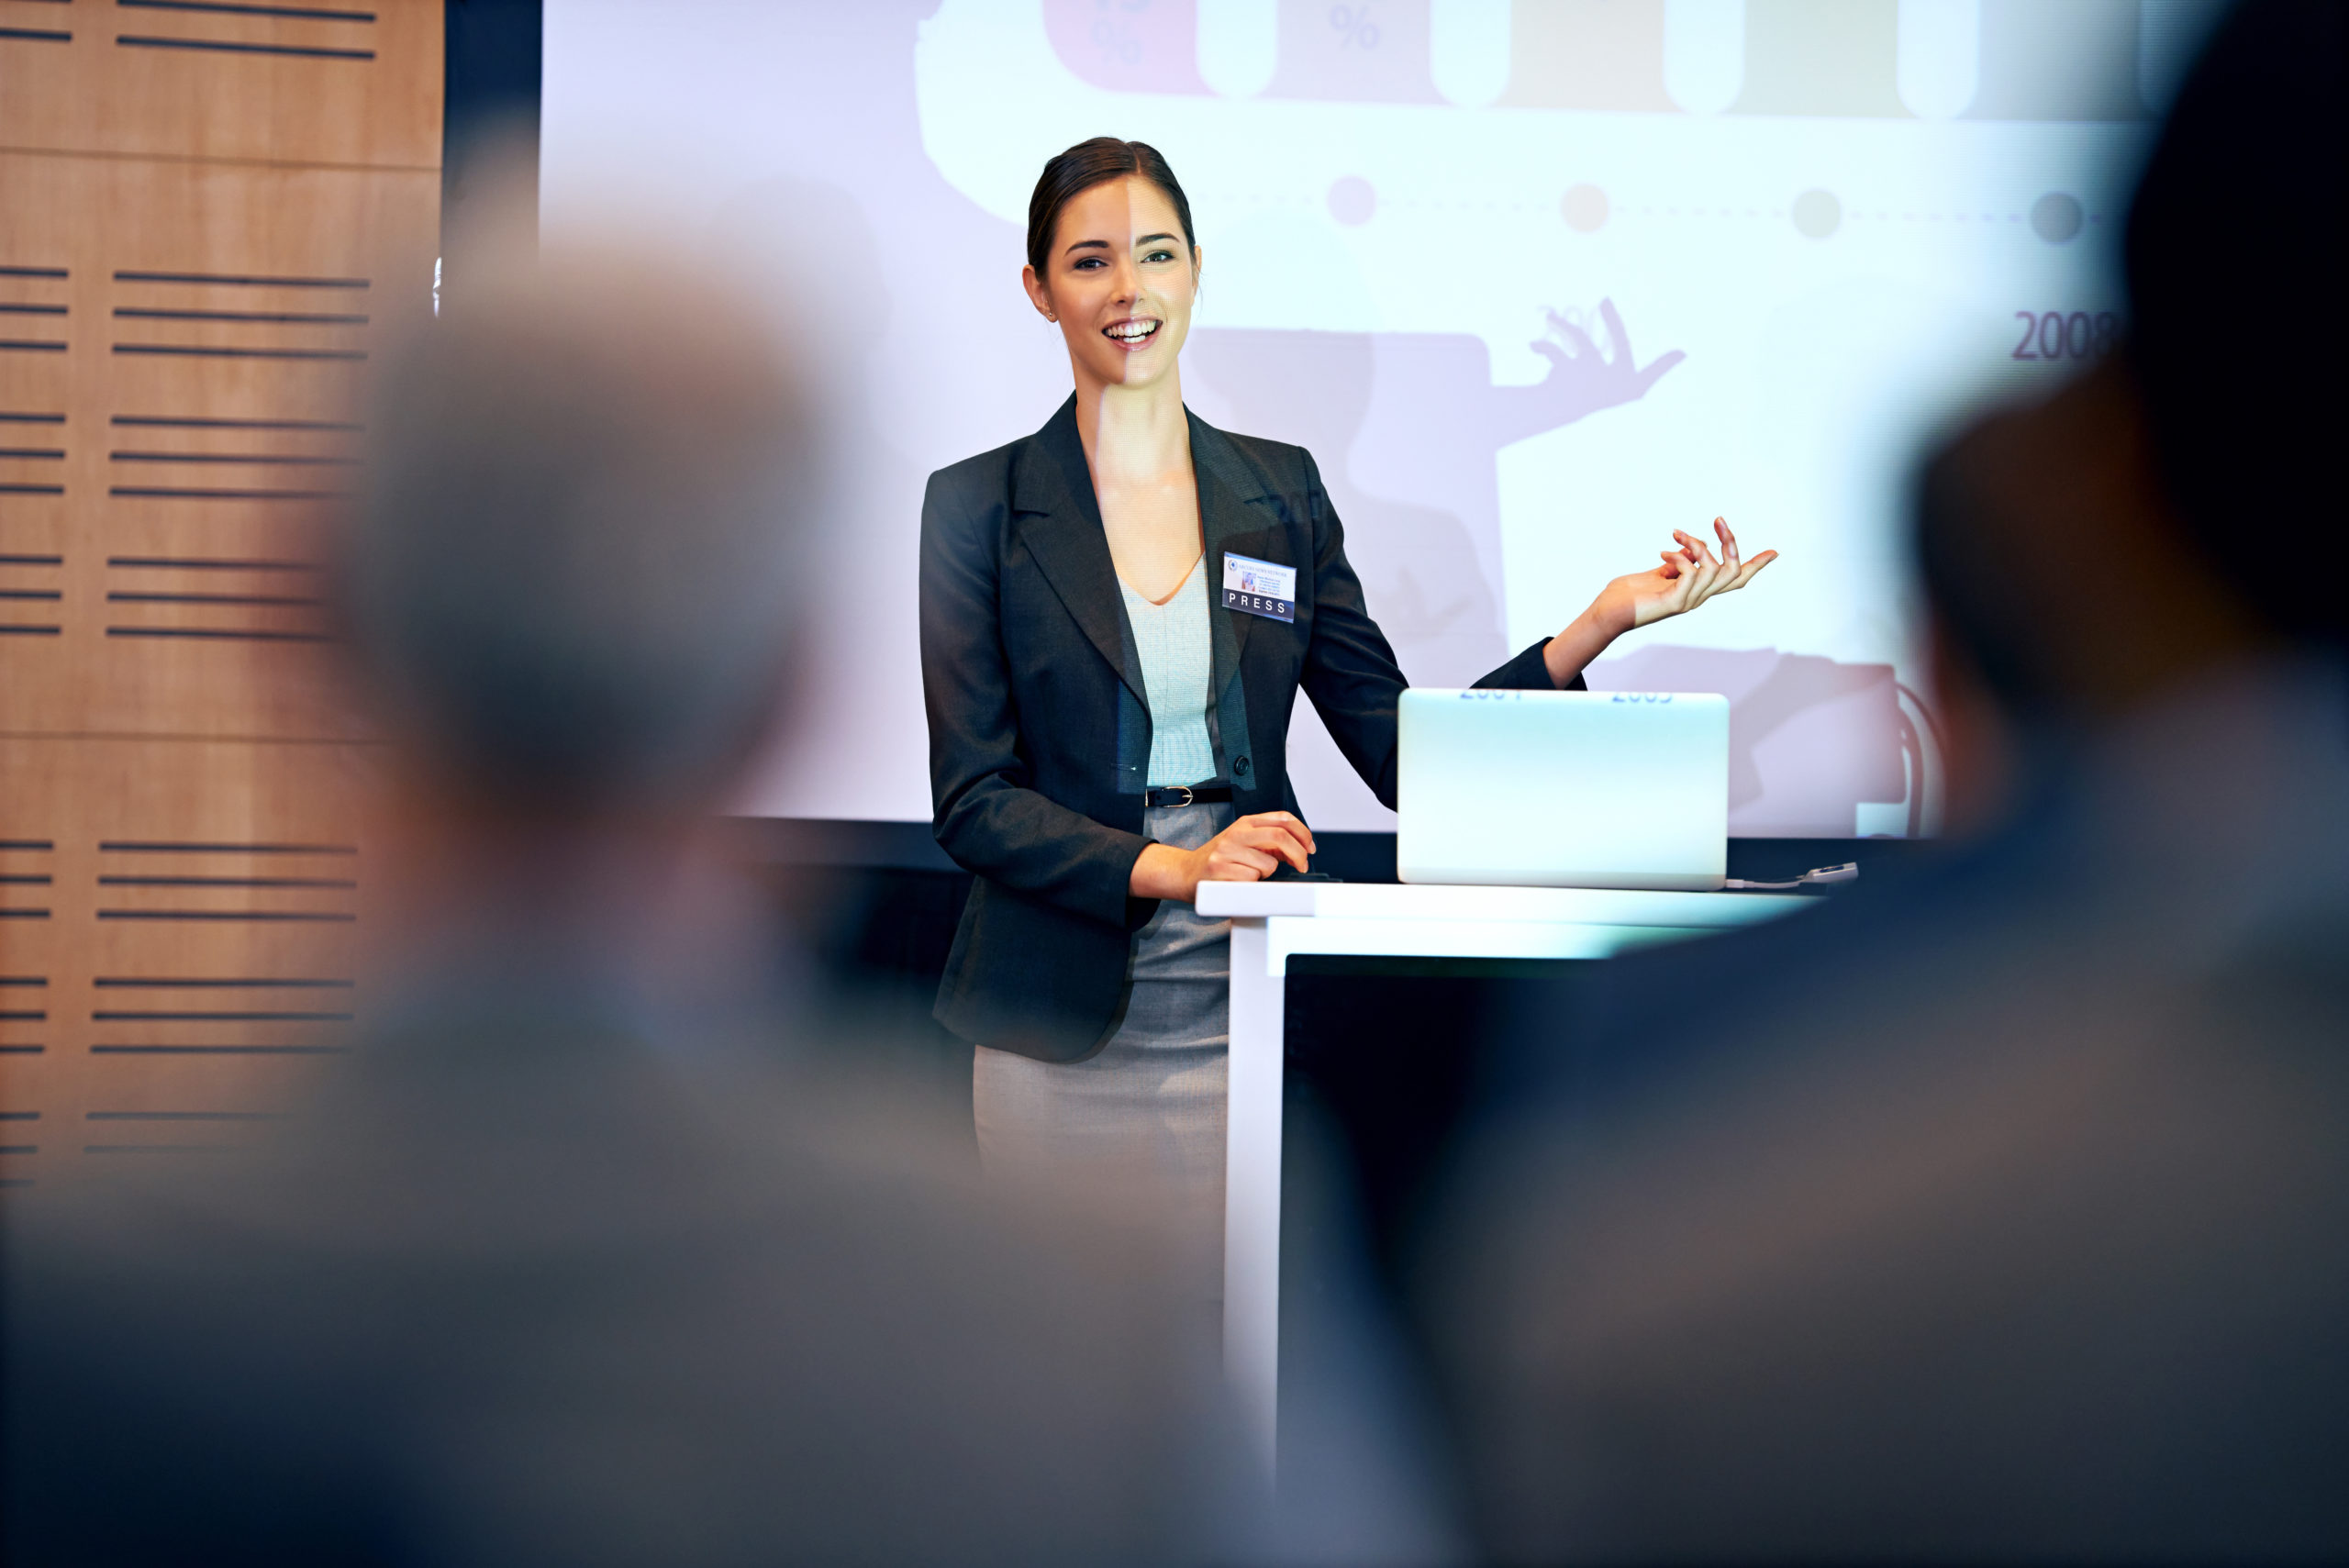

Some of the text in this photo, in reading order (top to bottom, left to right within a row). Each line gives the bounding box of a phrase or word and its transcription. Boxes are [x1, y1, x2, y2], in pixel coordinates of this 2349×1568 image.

[1328, 4, 1381, 50] %
[2011, 311, 2116, 359] 2008
[1229, 593, 1286, 613] PRESS
